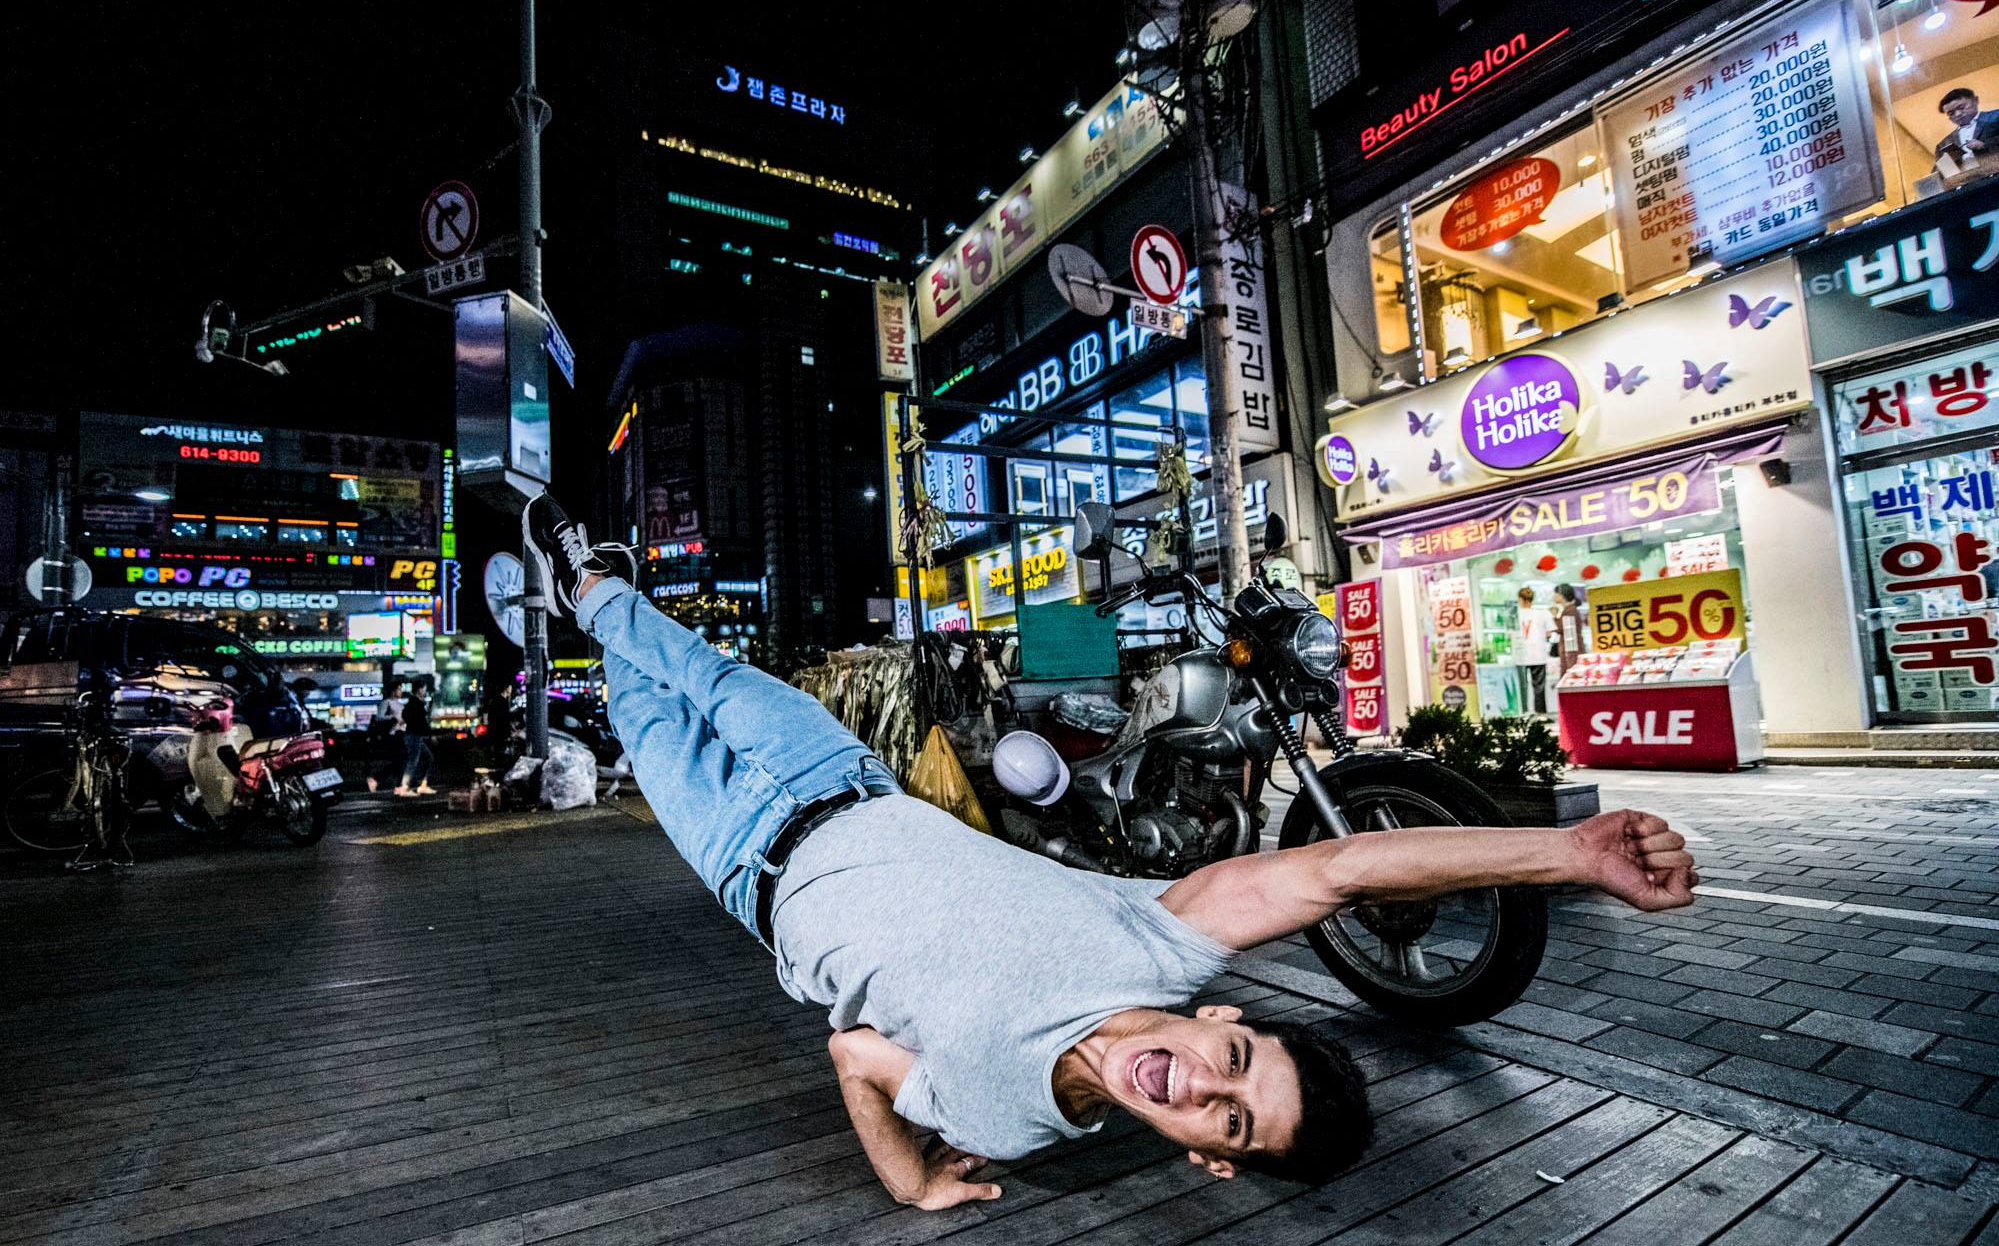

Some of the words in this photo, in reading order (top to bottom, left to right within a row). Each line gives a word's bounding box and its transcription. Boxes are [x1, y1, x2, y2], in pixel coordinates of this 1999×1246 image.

[1644, 97, 1677, 122] 기장
[1683, 76, 1715, 100] 추가
[1720, 57, 1754, 84] 없는
[1761, 30, 1800, 62] 가격
[1360, 86, 1441, 152] Beauty
[1450, 32, 1527, 93] Salon
[1638, 191, 1697, 225] 남자컷트
[1640, 210, 1698, 242] 여자컷트
[1724, 226, 1753, 246] 카드
[931, 183, 1036, 319] 전당포
[427, 257, 482, 290] 일방통행
[1134, 305, 1182, 335] 일방통
[1229, 256, 1271, 432] 종로김밥
[1472, 380, 1562, 424] Holika
[1856, 361, 1992, 430] 처방
[1475, 408, 1563, 450] Holika
[180, 446, 260, 463] 614-9300
[1872, 470, 1995, 521] 백제
[1509, 490, 1606, 536] SALE
[127, 566, 192, 583] POPO
[198, 566, 251, 587] PC
[390, 560, 437, 580] PC
[135, 591, 235, 607] COFFEE
[257, 593, 339, 609] BESCO
[1347, 588, 1370, 602] SALE
[1347, 600, 1371, 619] 50
[1439, 608, 1465, 628] 50
[1596, 609, 1644, 633] BIG
[1351, 639, 1374, 652] SALE
[1597, 633, 1646, 650] SALE
[1351, 651, 1375, 671] 50
[1444, 661, 1471, 681] 50
[1354, 688, 1376, 701] SALE
[1354, 700, 1378, 719] 50
[1589, 709, 1695, 745] SALE
